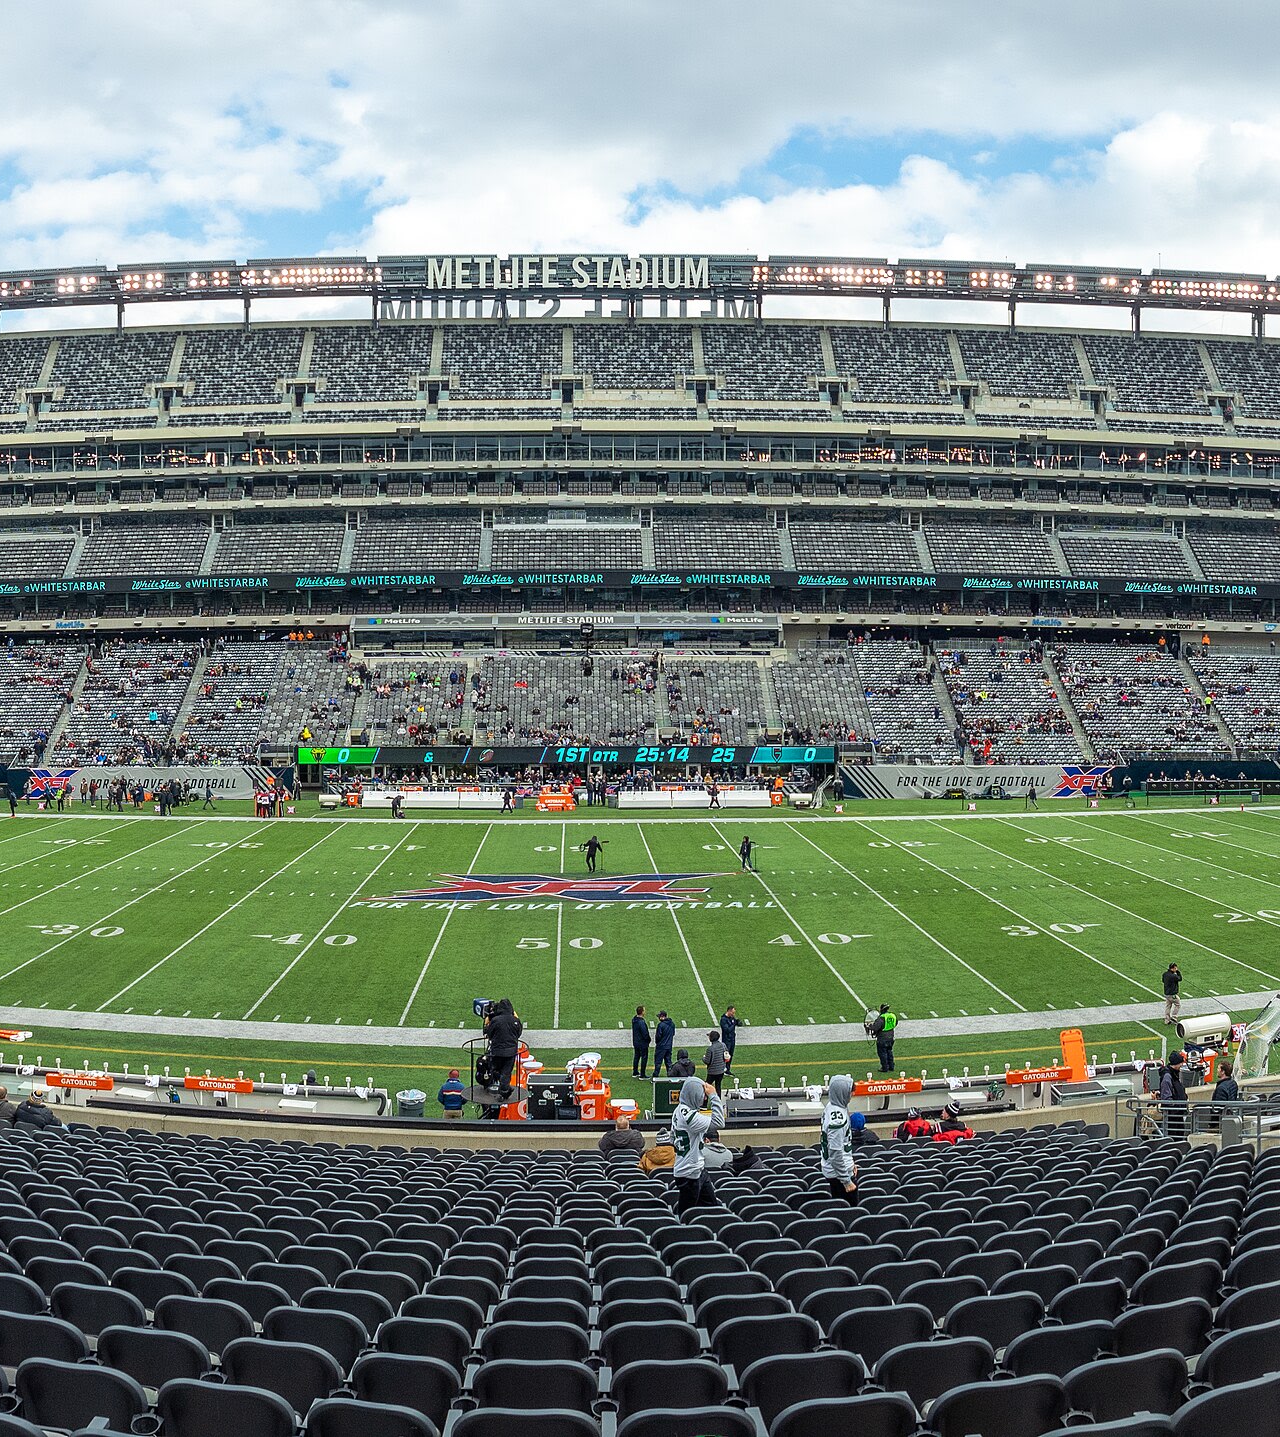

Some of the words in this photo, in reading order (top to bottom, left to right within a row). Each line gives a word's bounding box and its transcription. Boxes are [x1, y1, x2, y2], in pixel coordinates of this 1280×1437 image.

[427, 257, 561, 290] METLIFE
[571, 256, 709, 290] STADIUM
[185, 577, 268, 588] @WHITESTARBAR
[351, 575, 436, 586] @WHITESTARBAR
[518, 574, 603, 584] @WHITESTARBAR
[686, 574, 771, 584] @WHITESTARBAR
[853, 576, 937, 587] @WHITESTARBAR
[1017, 579, 1099, 590] @WHITESTARBAR
[24, 581, 106, 593] @WHITESTARBAR
[1177, 584, 1257, 596] @WHITESTARBAR
[56, 621, 85, 629] MetLife
[518, 616, 563, 624] METLIFE
[566, 616, 614, 624] STADIUM
[1166, 622, 1191, 630] verizon
[337, 748, 350, 763] 0
[424, 752, 433, 763] &
[556, 748, 589, 763] 1ST
[593, 750, 618, 763] QTR
[635, 748, 689, 763] 25:14
[711, 748, 735, 763] 25
[804, 748, 816, 762] 0
[138, 778, 163, 789] LOVE
[186, 778, 237, 789] FOOTBALL
[897, 777, 917, 787] FOR
[922, 777, 941, 787] THE
[946, 777, 972, 787] LOVE
[976, 777, 990, 787] OF
[993, 777, 1046, 787] FOOTBALL
[349, 901, 404, 910] FOR
[422, 901, 475, 910] THE
[487, 901, 575, 911] LOVE
[581, 901, 614, 910] OF
[631, 901, 779, 910] FOOTBALL
[576, 1071, 585, 1081] G
[1022, 1070, 1059, 1081] GATORADE
[60, 1078, 97, 1088] GATORADE
[199, 1081, 236, 1090] GATORADE
[868, 1083, 906, 1092] GATORADE
[581, 1099, 596, 1119] G
[830, 1110, 844, 1121] 33
